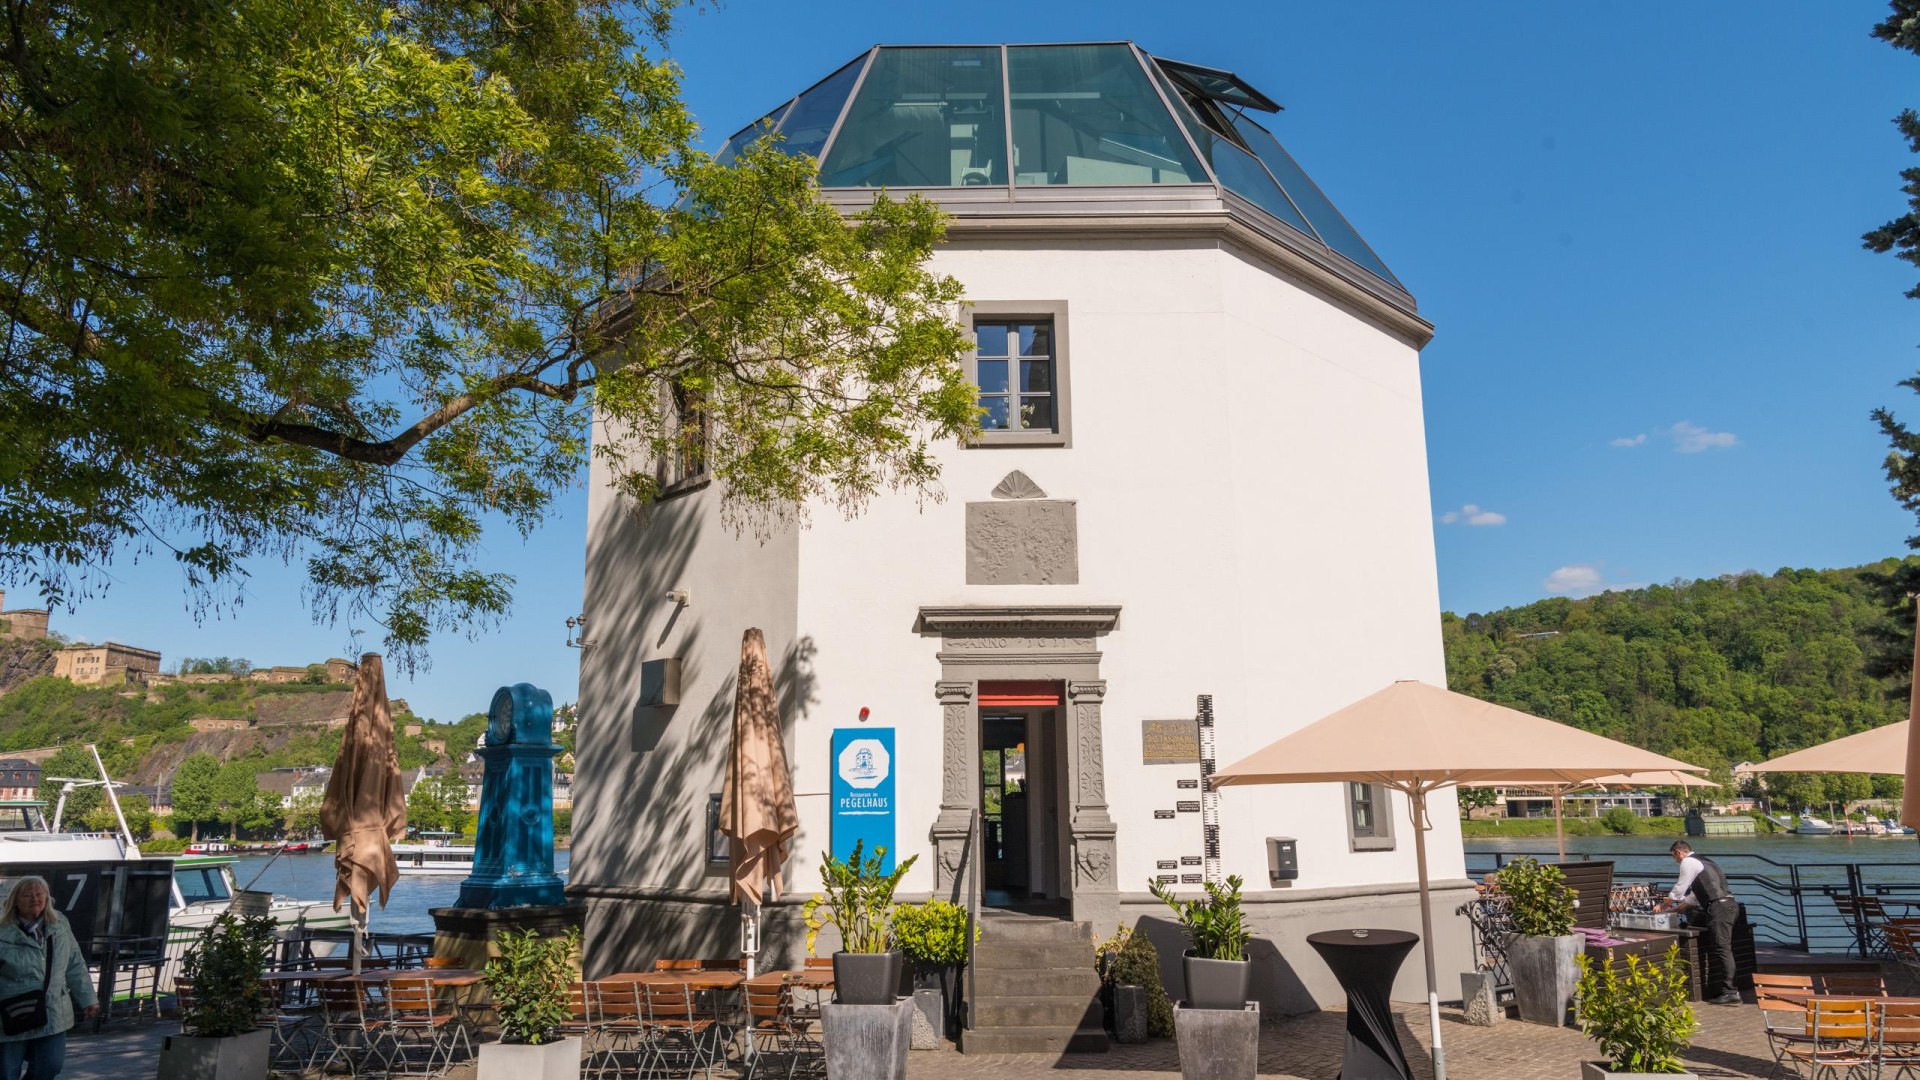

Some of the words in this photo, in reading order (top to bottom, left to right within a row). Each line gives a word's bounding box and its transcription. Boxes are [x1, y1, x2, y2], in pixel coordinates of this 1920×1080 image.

[965, 637, 1008, 649] ANNO
[840, 797, 888, 809] PEGELHAUS
[65, 873, 88, 911] 7
